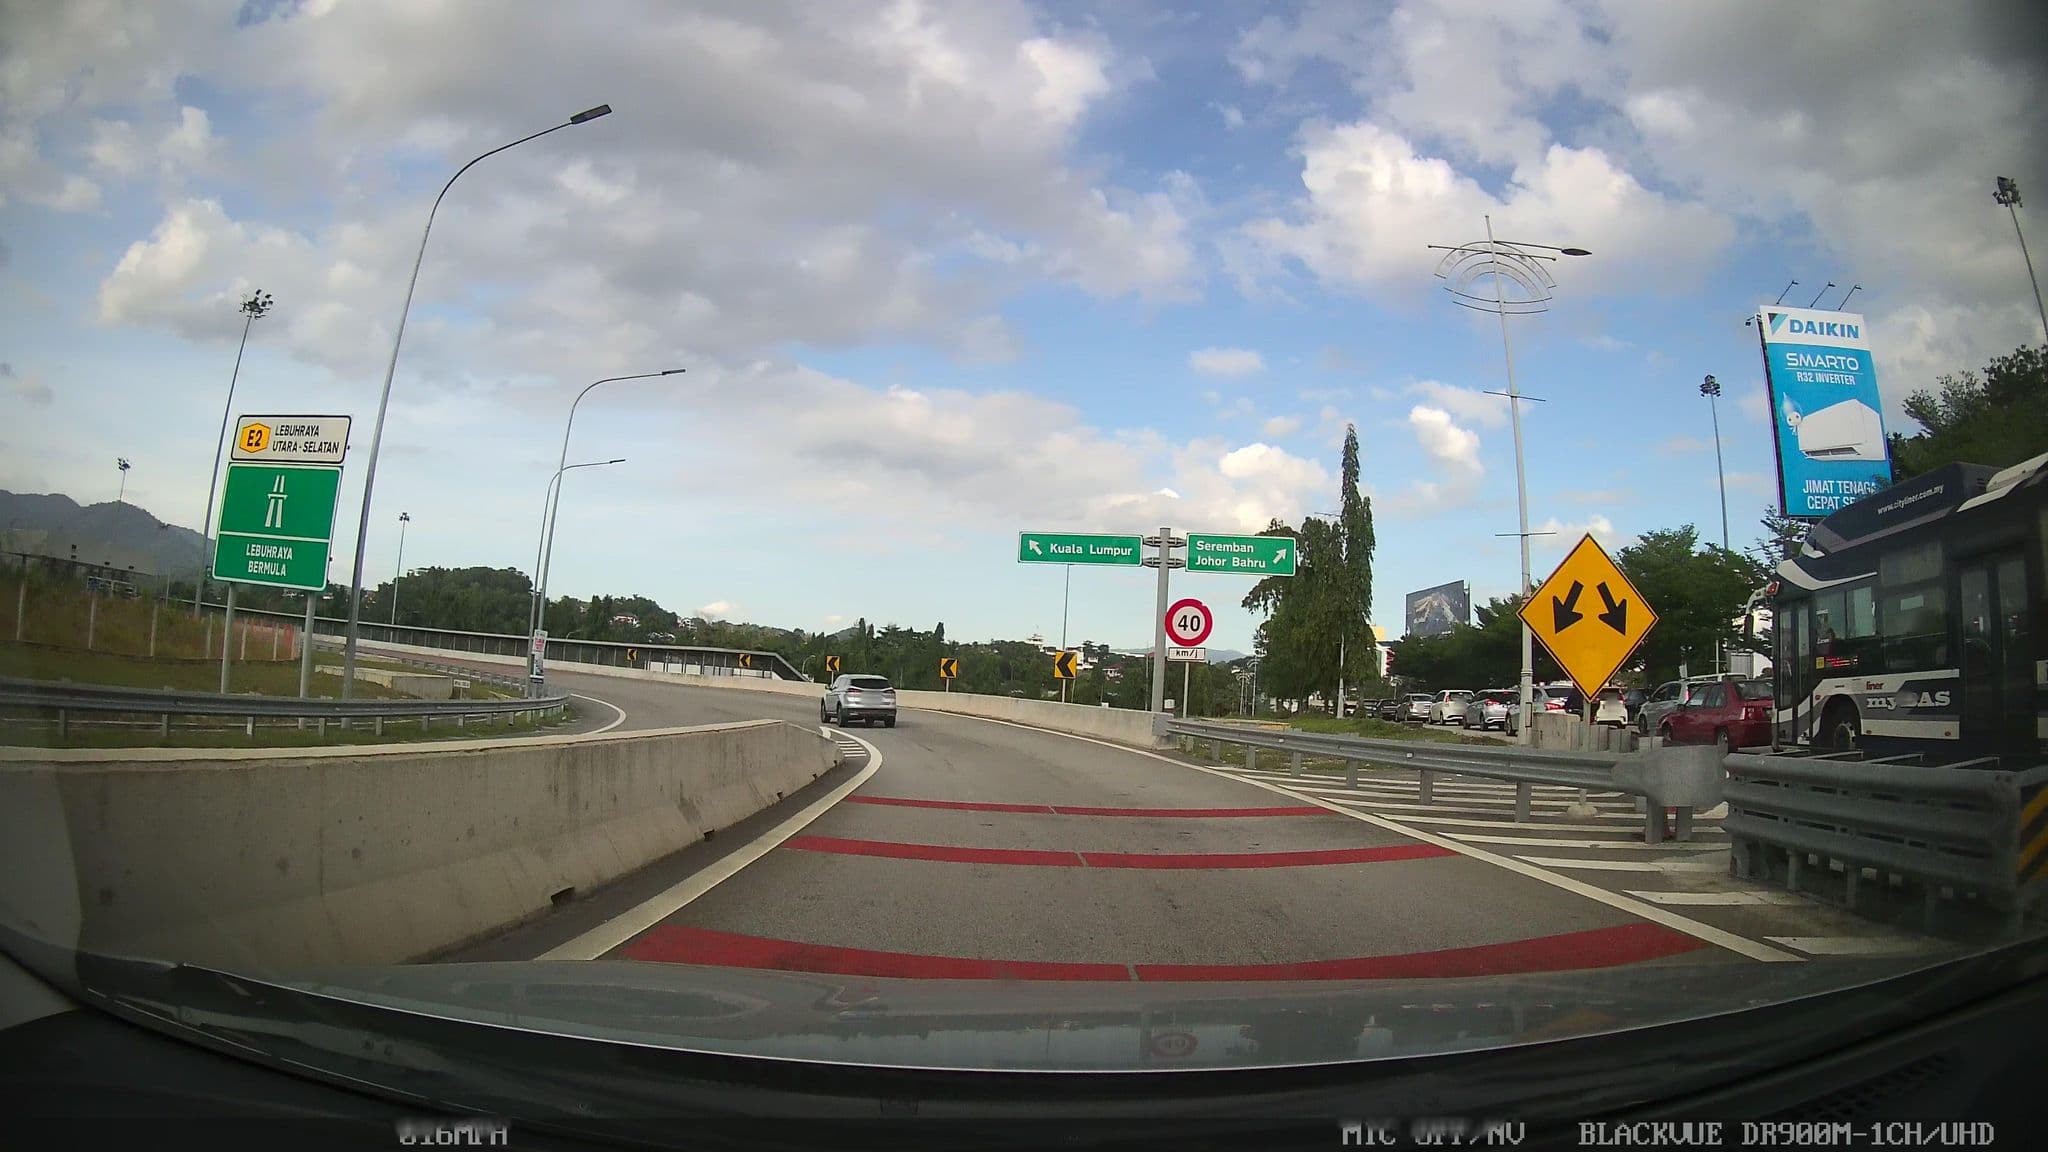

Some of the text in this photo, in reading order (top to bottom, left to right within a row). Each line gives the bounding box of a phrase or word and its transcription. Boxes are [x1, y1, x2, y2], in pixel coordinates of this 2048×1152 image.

[1789, 319, 1859, 339] DAIKIN
[1786, 352, 1859, 371] SMARTO
[1797, 372, 1856, 385] R32 INVERTER
[246, 429, 263, 447] E2
[275, 425, 320, 437] LEBUHRAYA
[1803, 480, 1876, 495] JIMAT TENAGA
[1807, 495, 1840, 510] CEPAT
[1877, 484, 1945, 515] www.cityliner.com.my
[246, 543, 293, 560] LEBUHRAYA
[1050, 543, 1133, 557] Kuala Lumpur
[1196, 540, 1254, 553] Seremban
[247, 561, 287, 576] BERMULA
[1195, 555, 1266, 569] Johor Bahru
[1178, 615, 1201, 632] 40
[1176, 649, 1198, 659] km/j
[1866, 681, 1885, 690] liner
[1866, 690, 1951, 710] myAS
